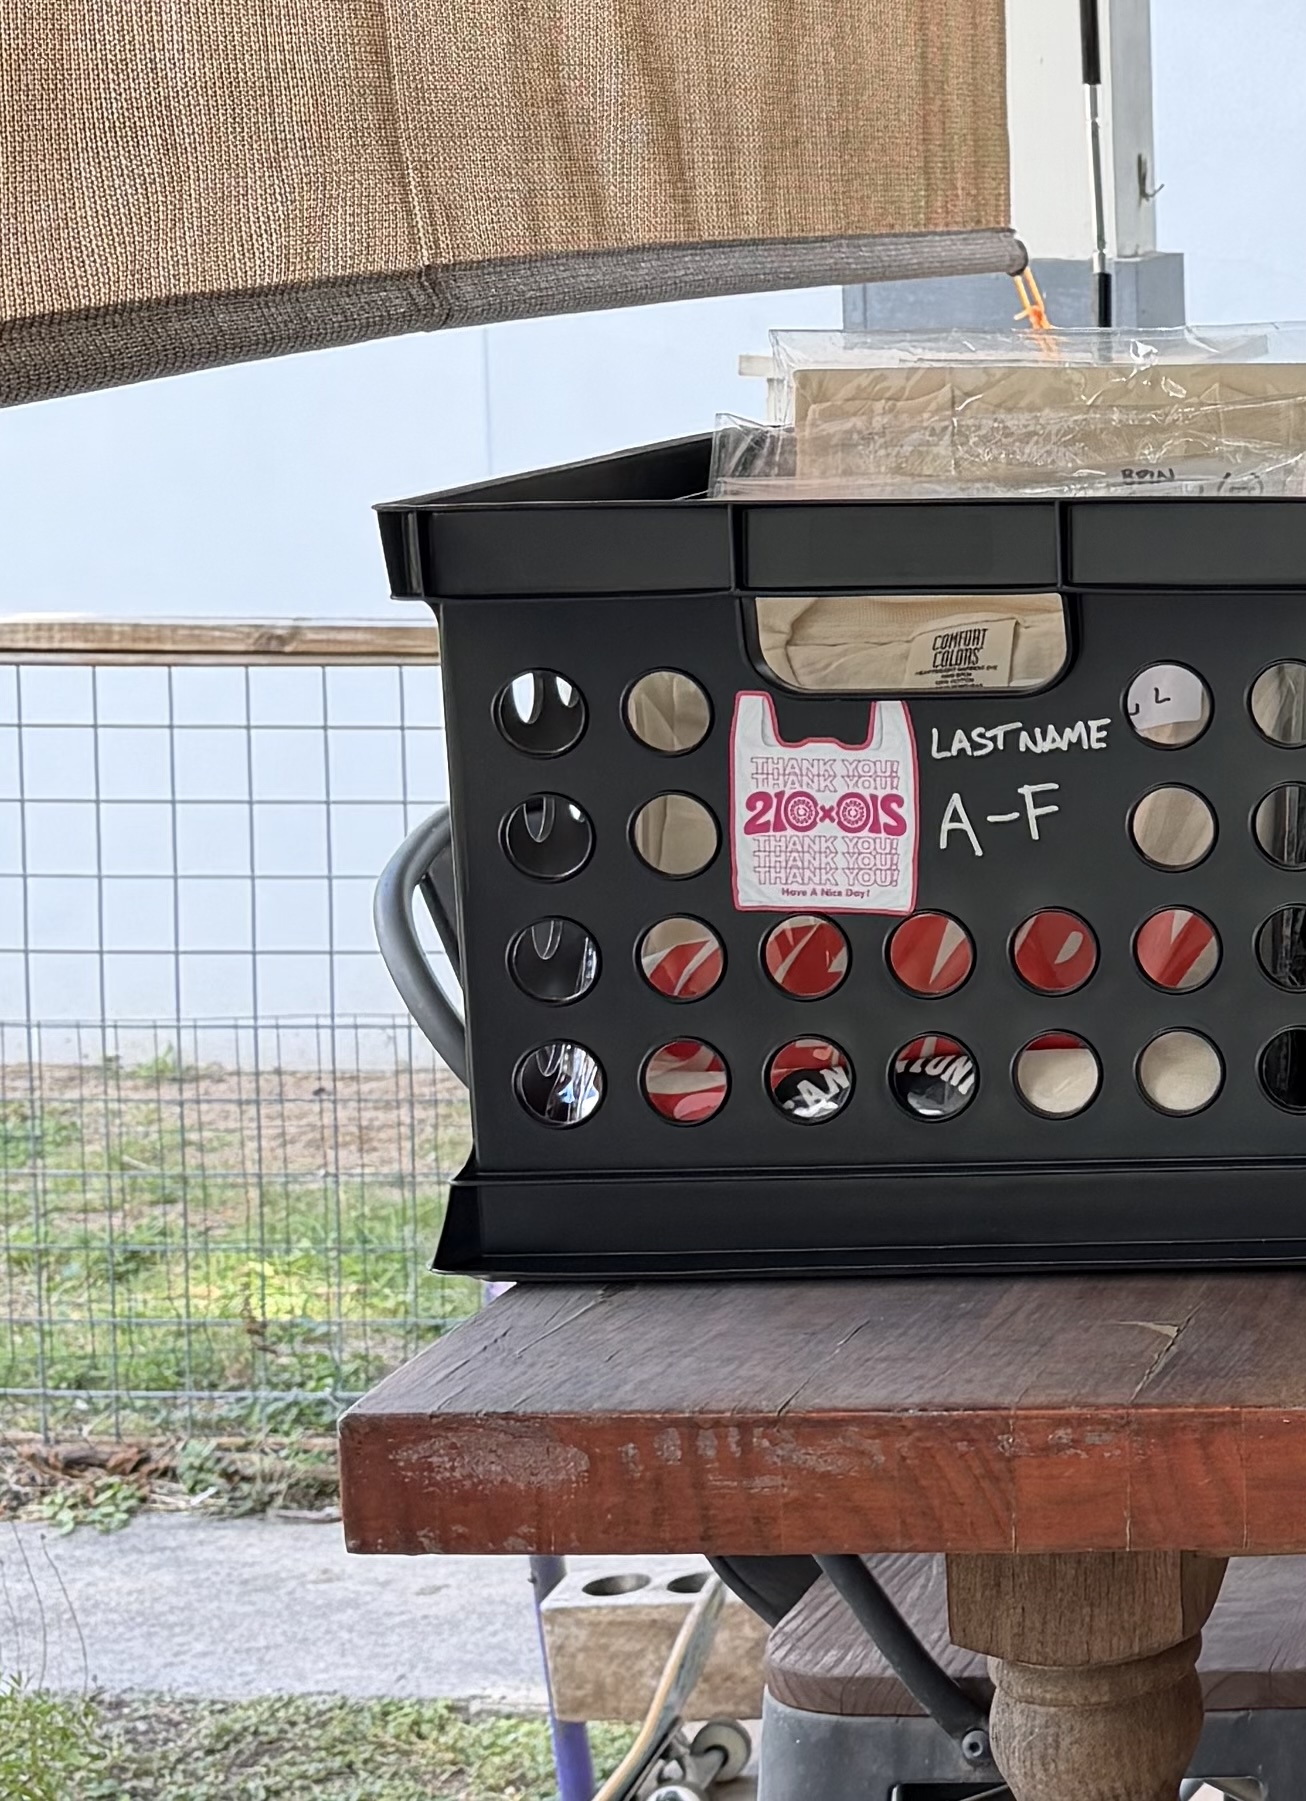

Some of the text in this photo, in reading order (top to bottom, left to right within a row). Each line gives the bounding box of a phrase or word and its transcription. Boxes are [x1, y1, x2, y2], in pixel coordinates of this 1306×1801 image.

[932, 628, 989, 651] COMFORT
[931, 718, 1112, 760] LAST NAME
[751, 757, 900, 778] THANK YOU!
[751, 773, 900, 793] THANK YOU!
[939, 782, 1060, 857] A-F
[752, 835, 899, 855] THANK YOU!
[752, 851, 900, 870] THANK YOU!
[752, 867, 900, 887] THANK YOU!
[781, 887, 870, 899] Have A Nice Day!
